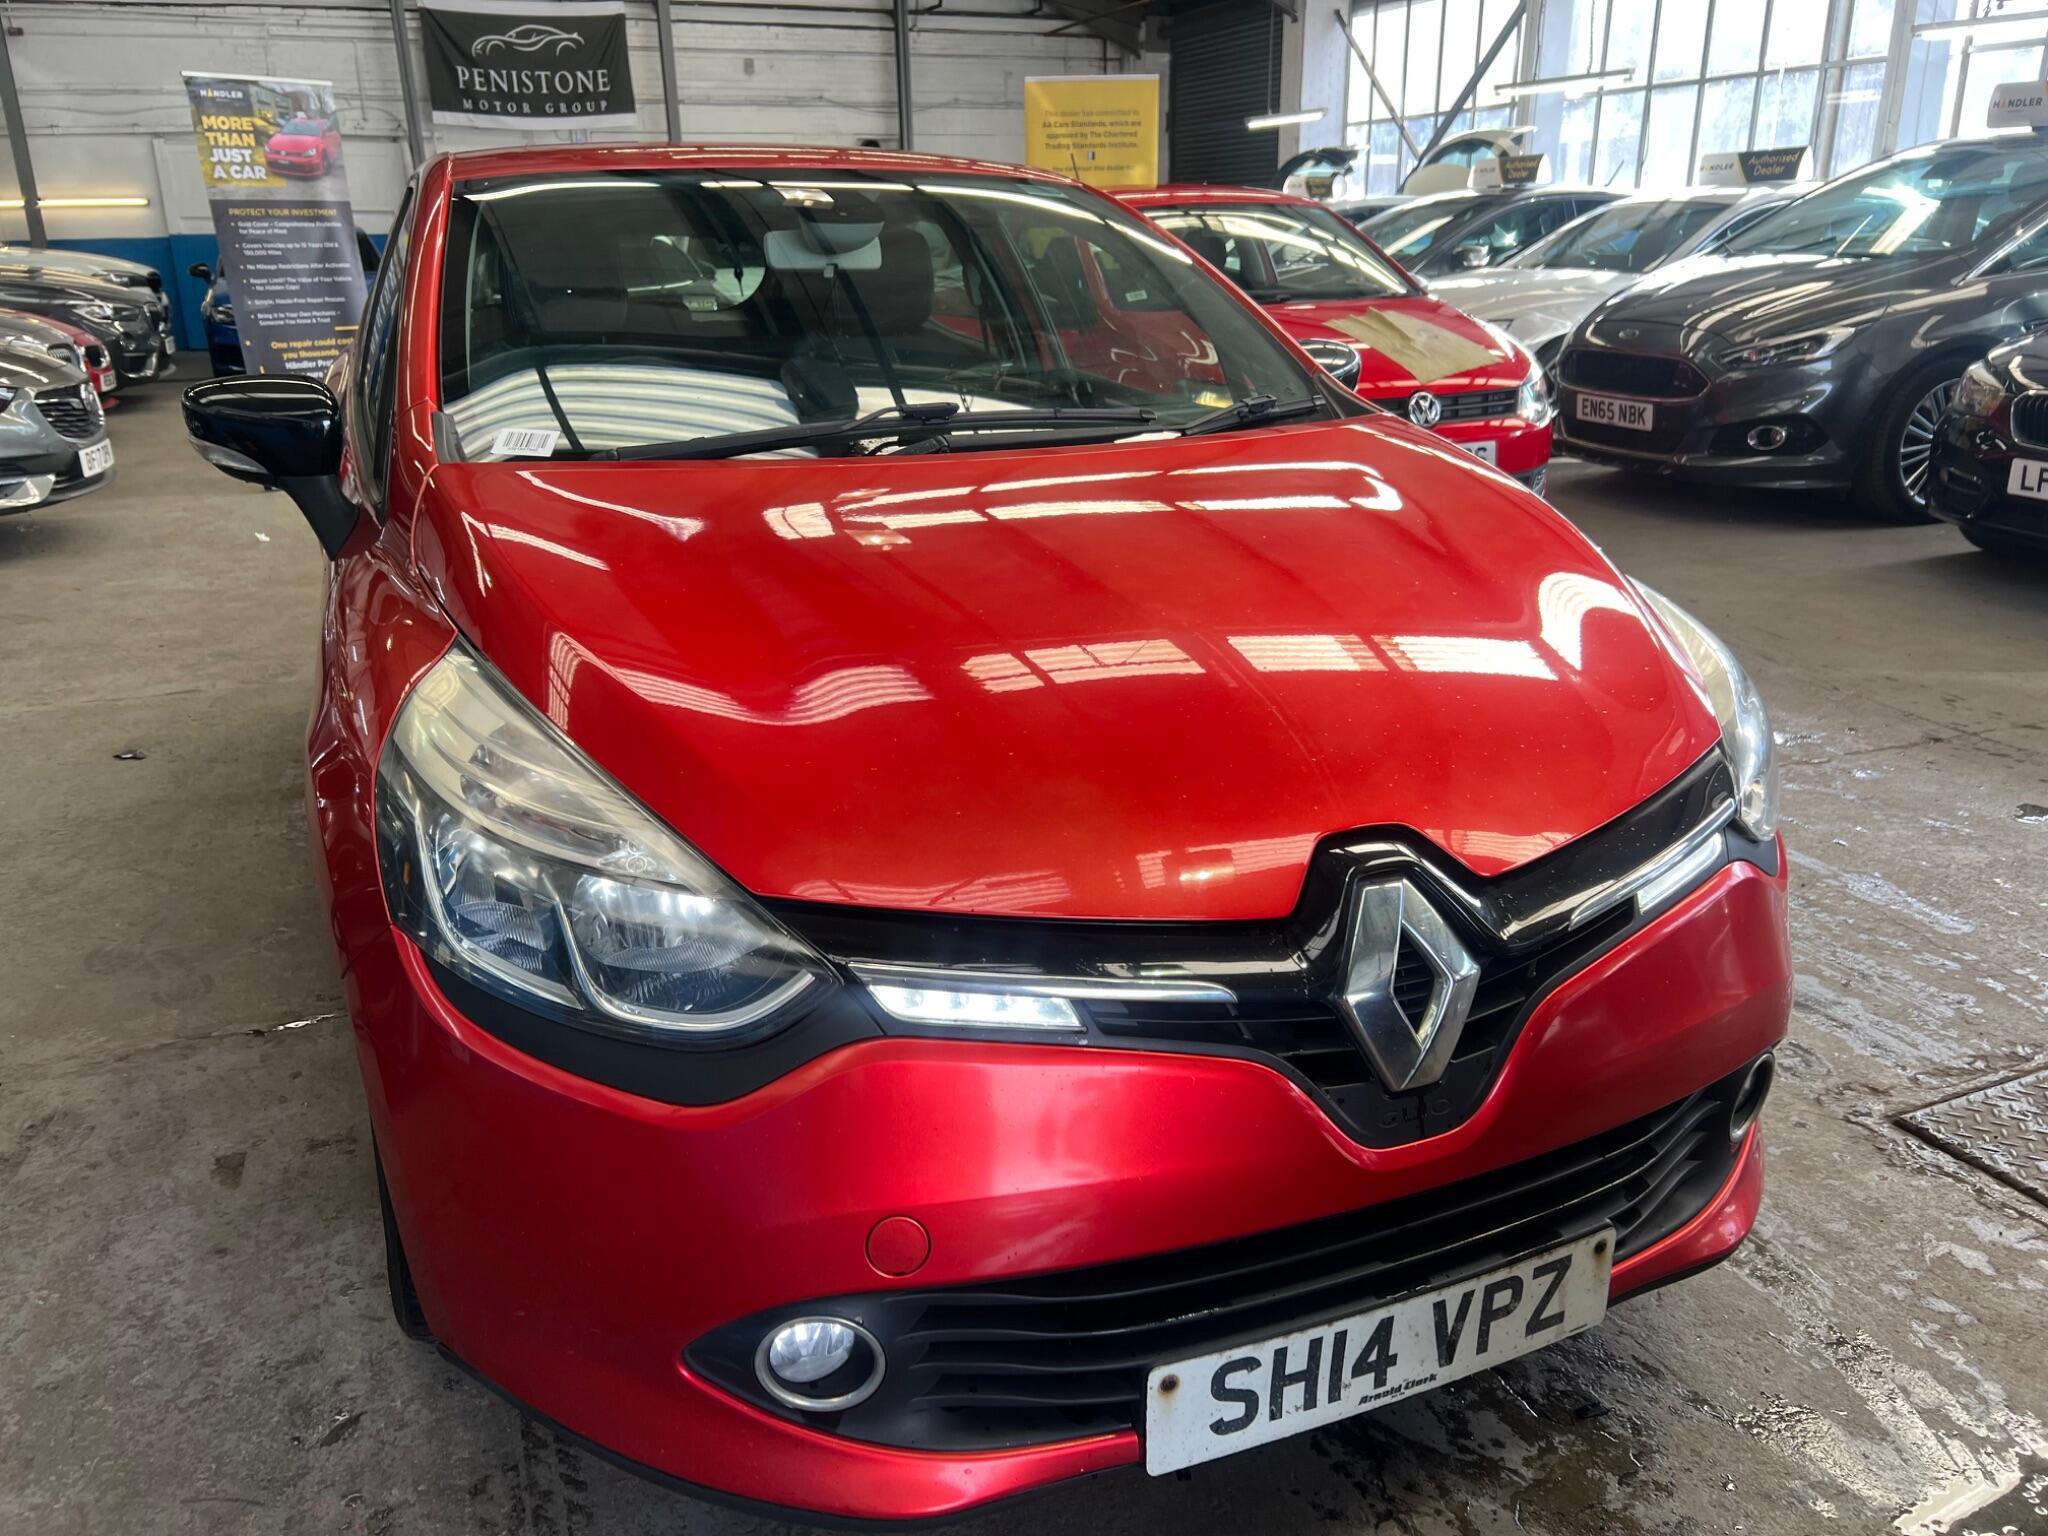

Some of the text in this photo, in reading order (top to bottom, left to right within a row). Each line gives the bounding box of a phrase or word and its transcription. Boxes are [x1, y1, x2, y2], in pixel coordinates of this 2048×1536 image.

[456, 65, 611, 94] PENISTONE
[462, 99, 608, 114] MOTOR GROUP
[201, 115, 254, 131] MORE
[205, 132, 256, 147] THAN
[209, 148, 253, 163] JUST
[1748, 152, 1801, 166] Authorised
[213, 164, 267, 179] A CAR
[1753, 164, 1785, 177] Dealer
[228, 207, 337, 216] PROTECT YOUR INVESTMENT
[271, 341, 288, 349] One
[289, 339, 313, 349] repair
[313, 338, 336, 347] could
[282, 352, 298, 360] you
[1581, 397, 1647, 427] EN65 NBK
[1209, 1254, 1573, 1437] SH14 VPZ
[1358, 1373, 1438, 1406] Arnold Clark
